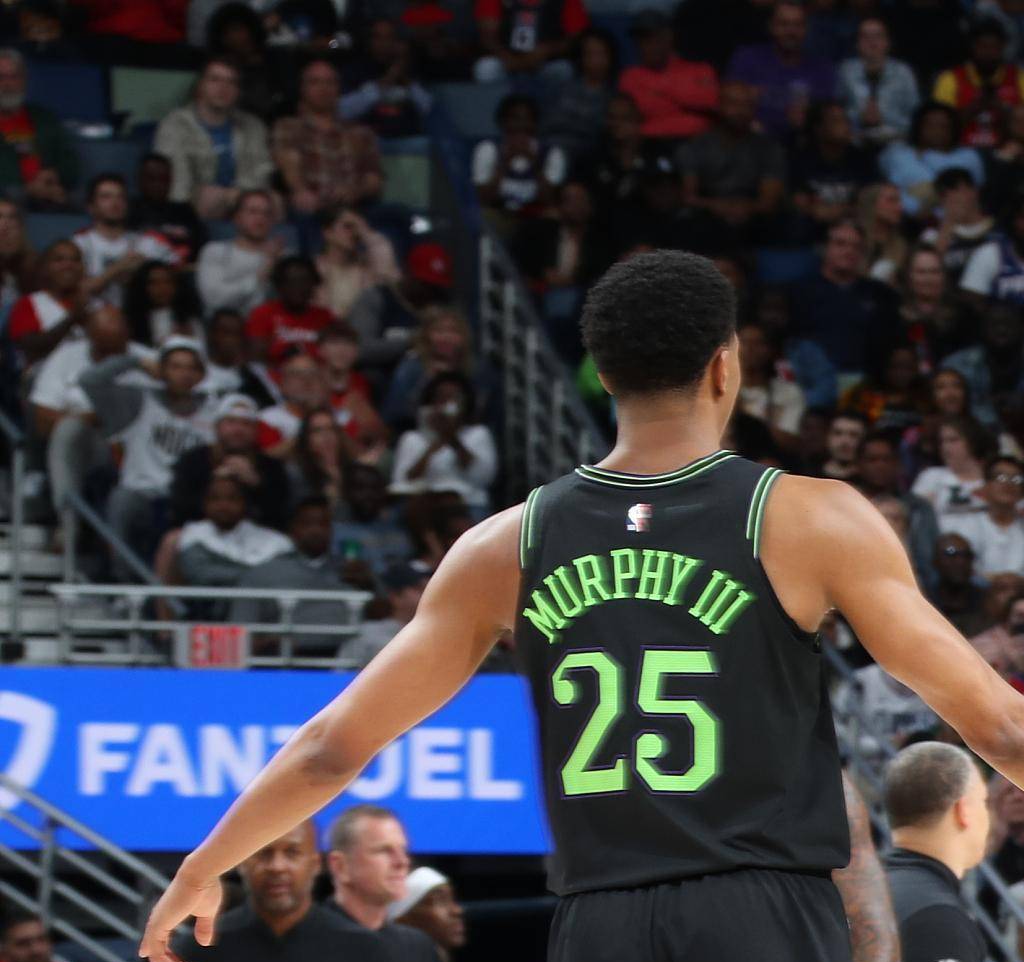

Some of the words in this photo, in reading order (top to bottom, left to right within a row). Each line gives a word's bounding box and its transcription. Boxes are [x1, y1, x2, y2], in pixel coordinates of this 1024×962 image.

[523, 549, 703, 644] MURPHY
[688, 570, 754, 635] III
[78, 722, 524, 800] FANUEL
[552, 647, 723, 798] 25
